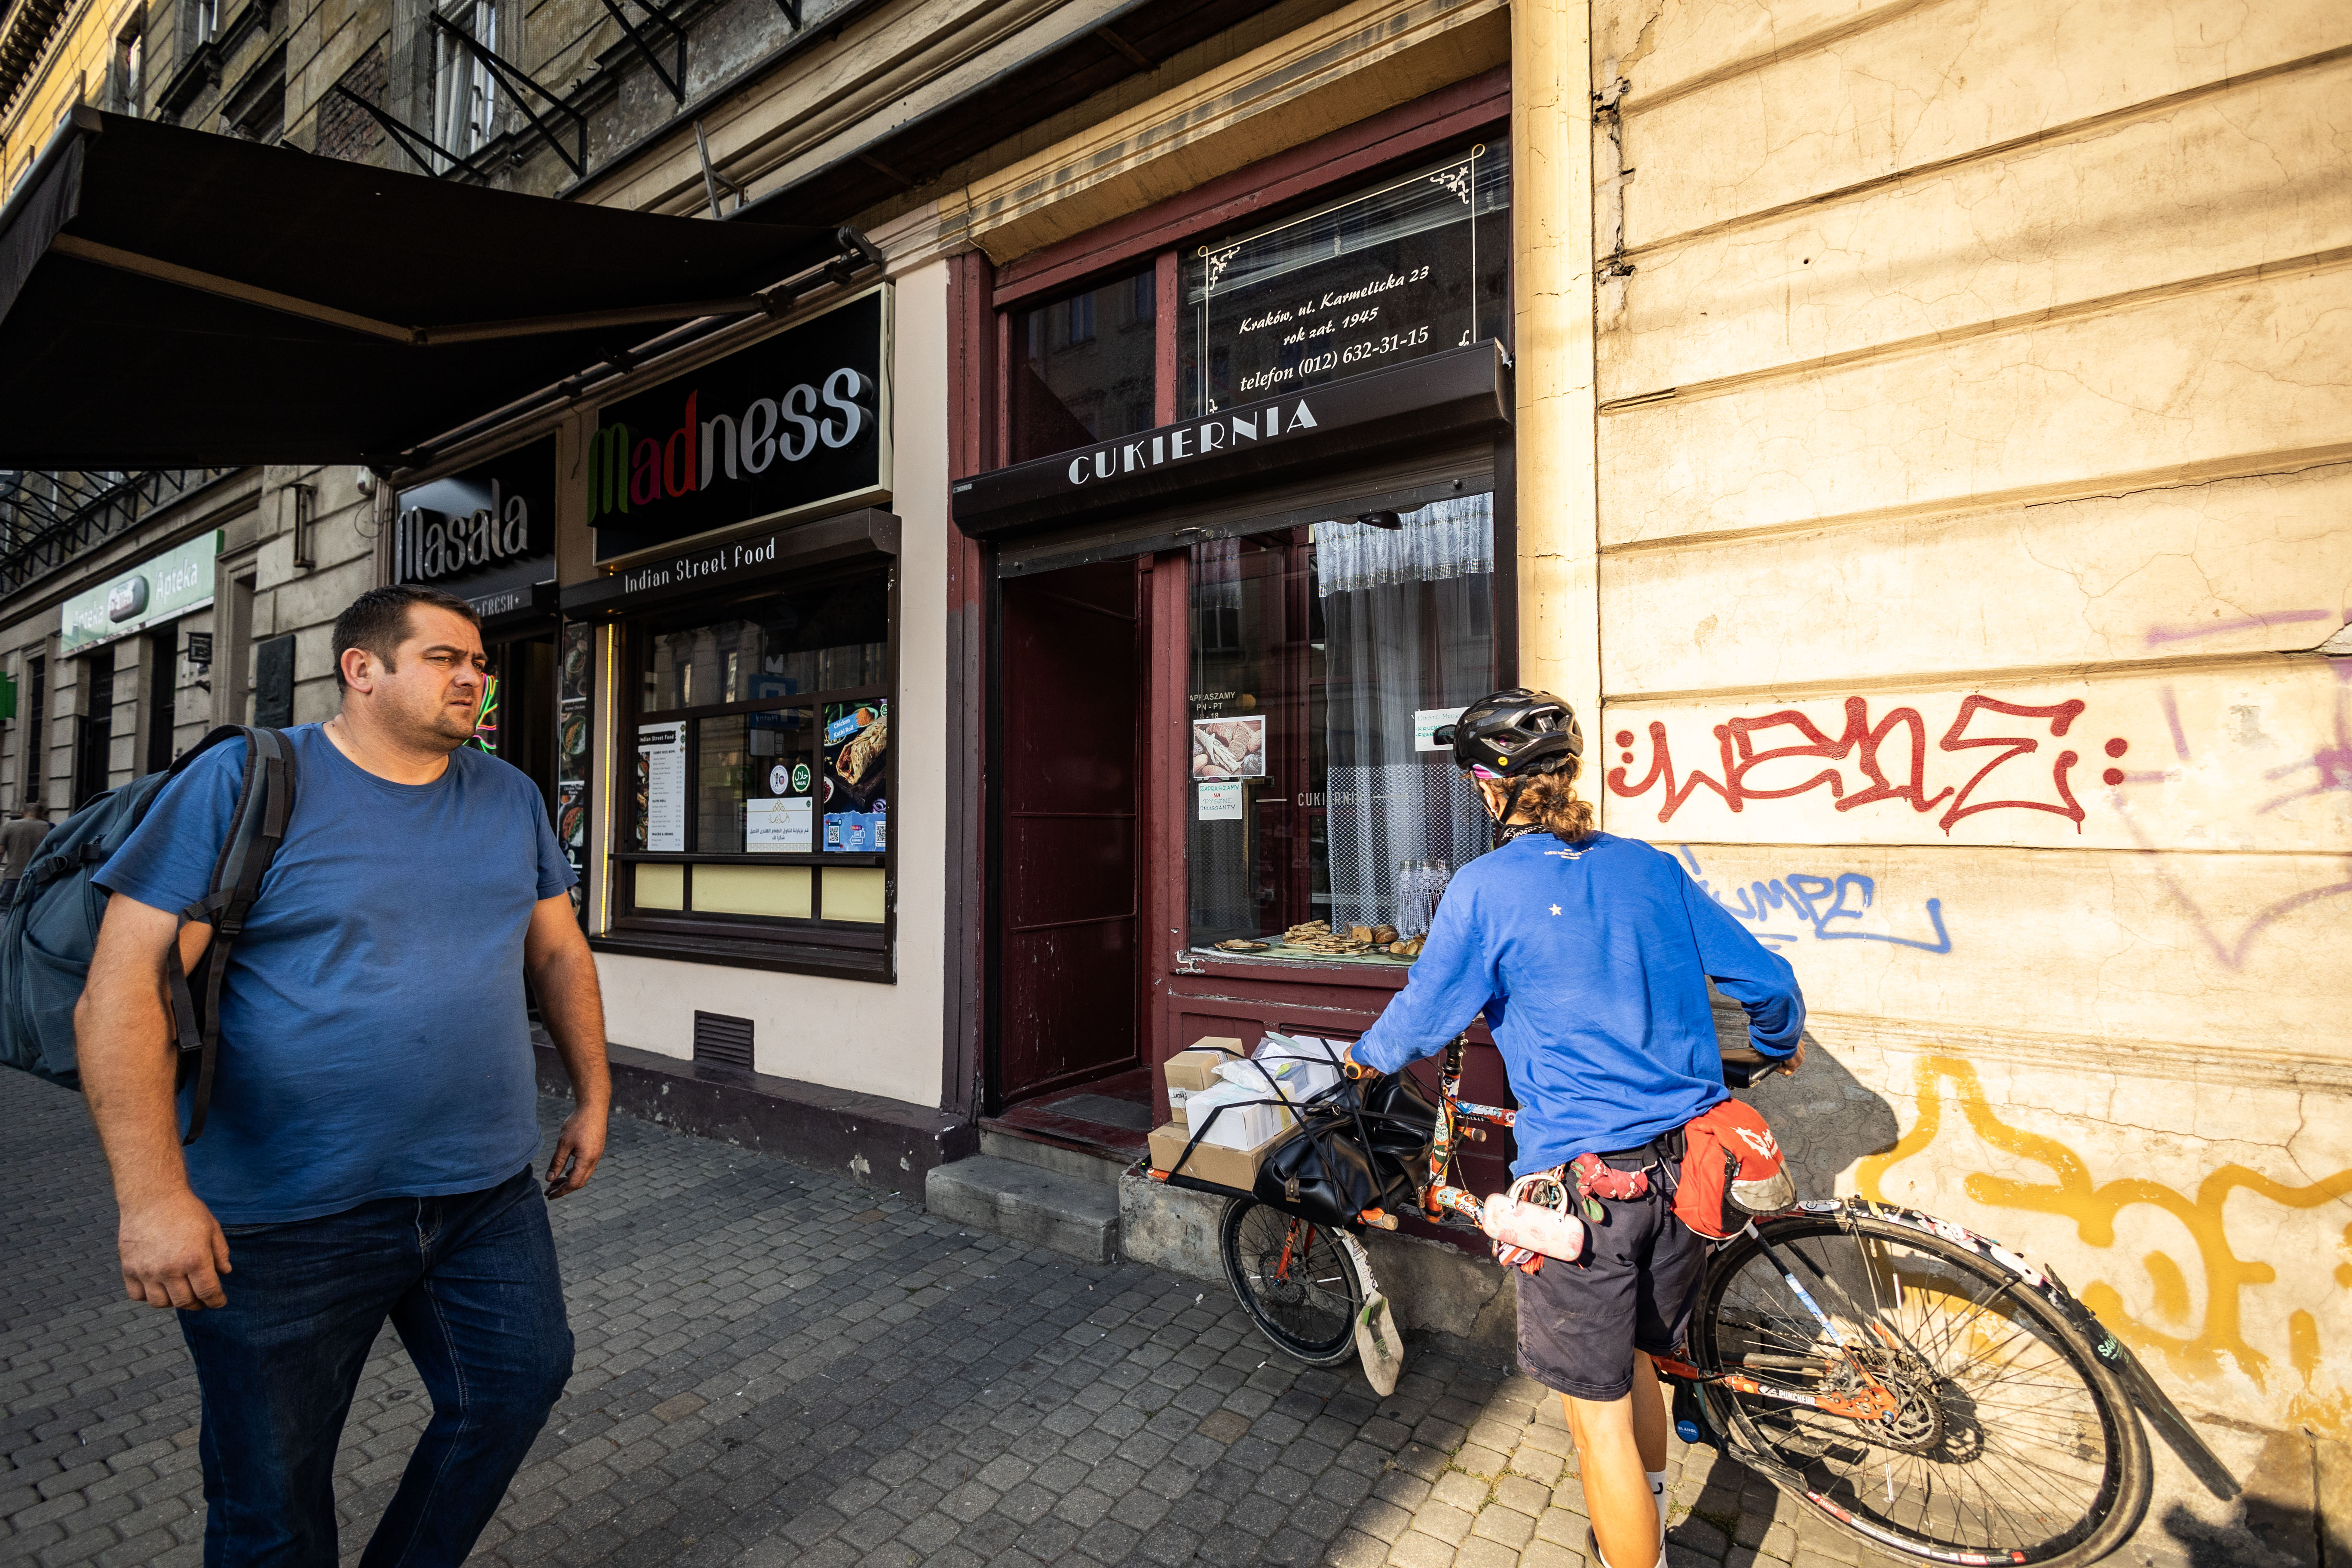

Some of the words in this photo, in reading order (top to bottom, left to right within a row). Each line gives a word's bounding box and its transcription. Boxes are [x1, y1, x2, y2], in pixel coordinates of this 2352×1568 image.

[1239, 309, 1292, 334] Kraków,
[1298, 300, 1315, 316] ul.
[1320, 273, 1404, 309] Karmelicka
[1409, 266, 1429, 281] 23
[1283, 331, 1305, 346] rok
[1342, 307, 1379, 328] 1945
[1240, 364, 1293, 392] telefon
[1298, 351, 1337, 378] (012)
[1343, 325, 1429, 364] 632-31-15
[1069, 399, 1317, 485] CUKIERNIA
[625, 569, 669, 594] Indian
[677, 550, 726, 581] Street
[735, 537, 775, 568] Food
[156, 557, 198, 606] Apteka
[482, 594, 514, 617] FRESH
[1190, 691, 1236, 702] APRASZAMY
[833, 718, 850, 729] Chicken
[833, 729, 845, 738] Kathi
[845, 725, 854, 733] Roll
[795, 771, 808, 781] حلال
[1779, 1389, 1816, 1406] PUNCHEUR
[1818, 1498, 1838, 1514] SWISS
